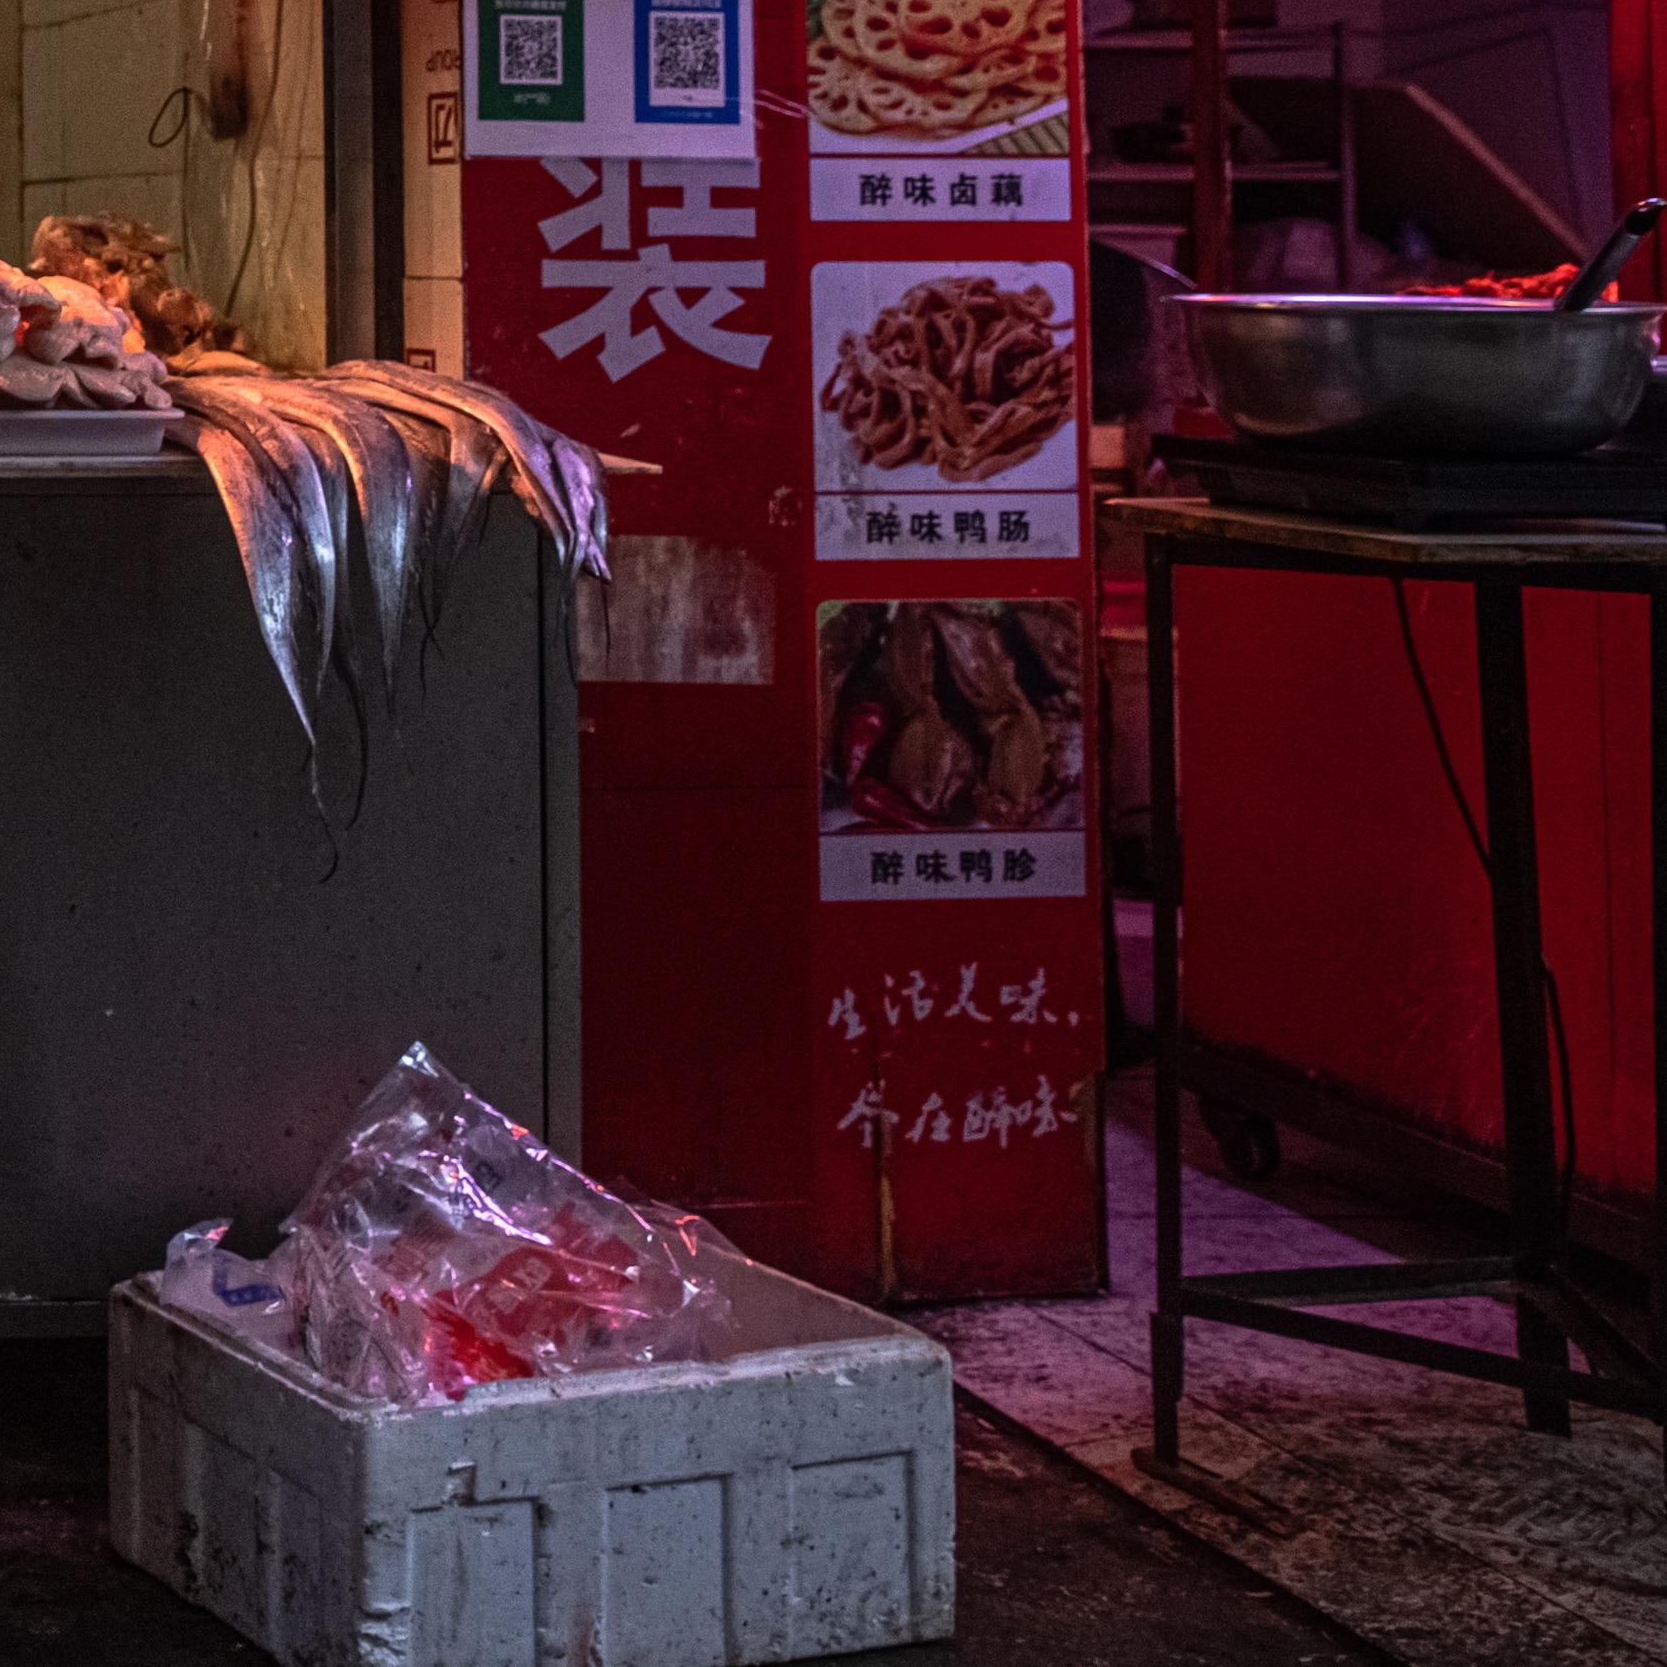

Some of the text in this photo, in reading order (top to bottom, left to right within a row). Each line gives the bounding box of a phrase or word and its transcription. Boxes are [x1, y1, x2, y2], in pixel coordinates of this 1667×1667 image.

[859, 172, 1025, 209] 醉味卤藕
[866, 509, 1030, 544] 醉味鸭肠
[870, 848, 1037, 885] 醉味鸭胗
